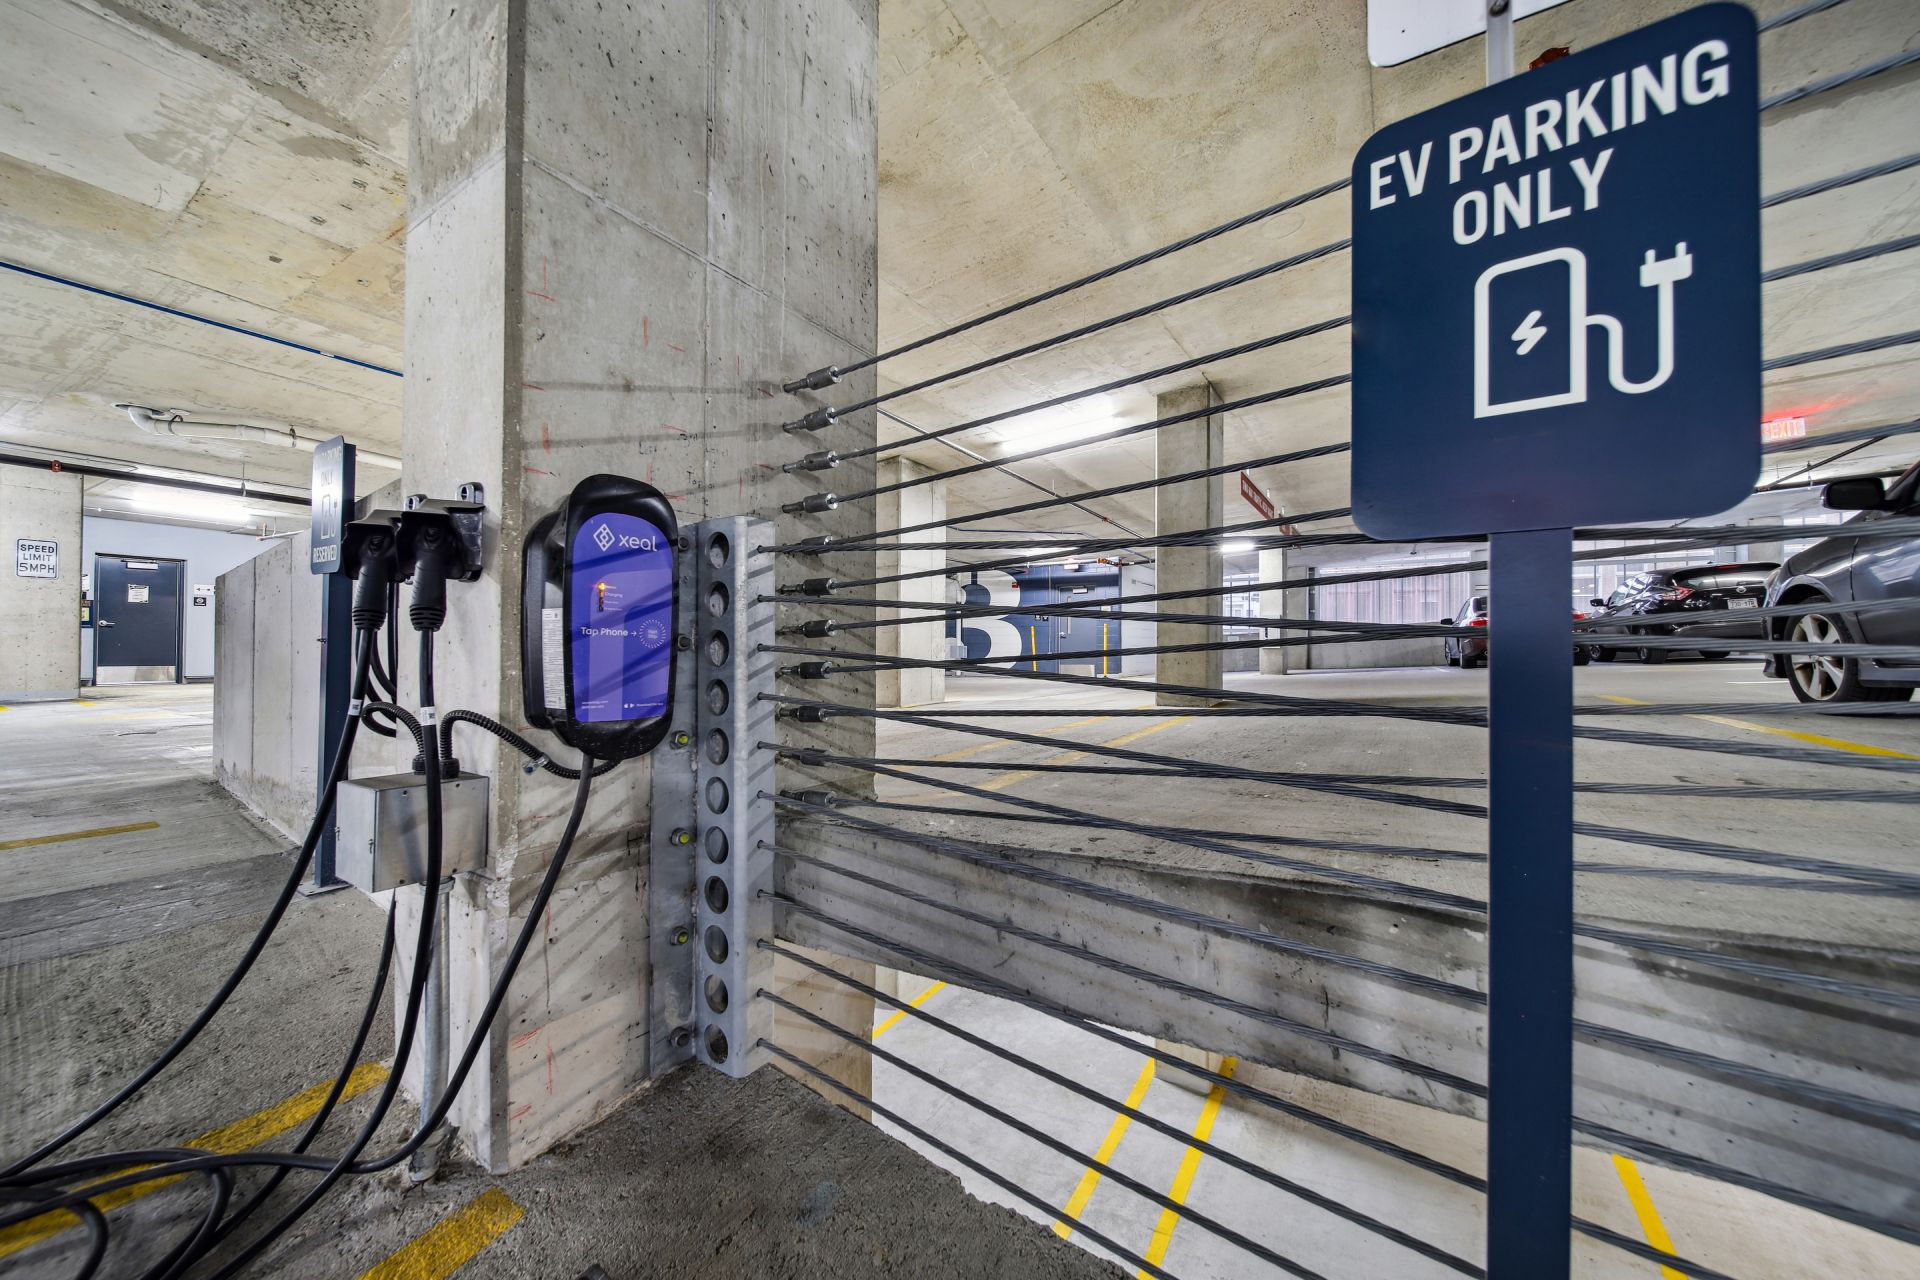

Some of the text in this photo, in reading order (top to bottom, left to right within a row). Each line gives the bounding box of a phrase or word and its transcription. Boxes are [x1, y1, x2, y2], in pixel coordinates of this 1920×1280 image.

[1369, 38, 1730, 211] EV PARKING
[1452, 147, 1615, 246] ONLY
[1770, 419, 1799, 438] EXIT
[20, 543, 55, 554] SPEED
[619, 534, 657, 552] xeal
[23, 553, 53, 562] LIMIT
[312, 545, 338, 563] RESERVED
[581, 626, 629, 637] Tap Phone
